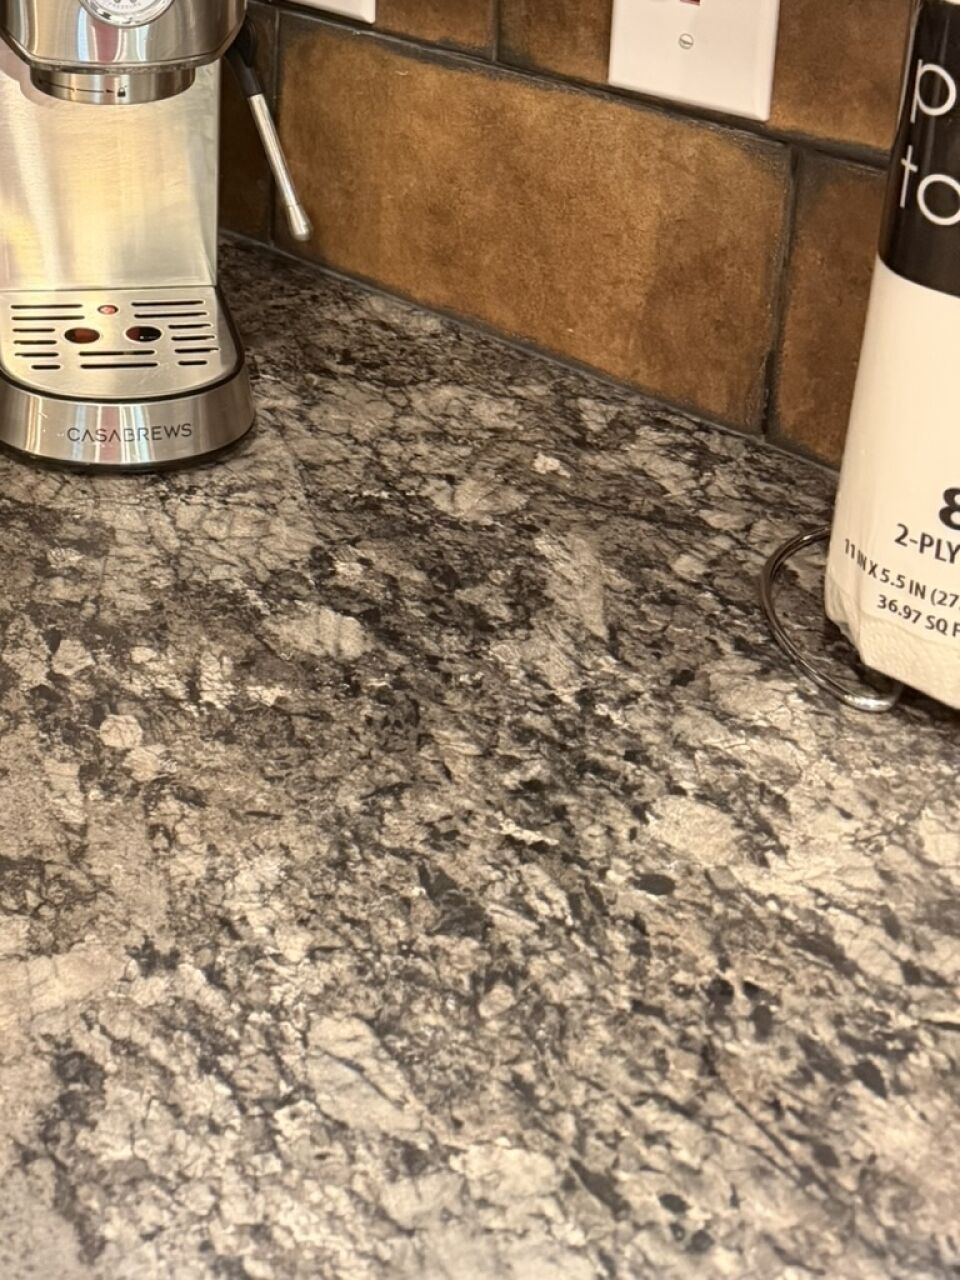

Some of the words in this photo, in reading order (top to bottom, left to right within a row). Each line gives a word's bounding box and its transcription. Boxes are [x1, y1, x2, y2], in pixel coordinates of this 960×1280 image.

[910, 59, 957, 124] p
[66, 423, 193, 442] CASABREWS
[894, 523, 960, 564] 2-PLY
[844, 538, 856, 559] 11
[857, 549, 868, 570] IN
[868, 560, 878, 579] X
[880, 569, 906, 589] 5.5
[909, 579, 927, 600] IN
[877, 594, 922, 624] 36.97
[925, 615, 948, 636] SQ
